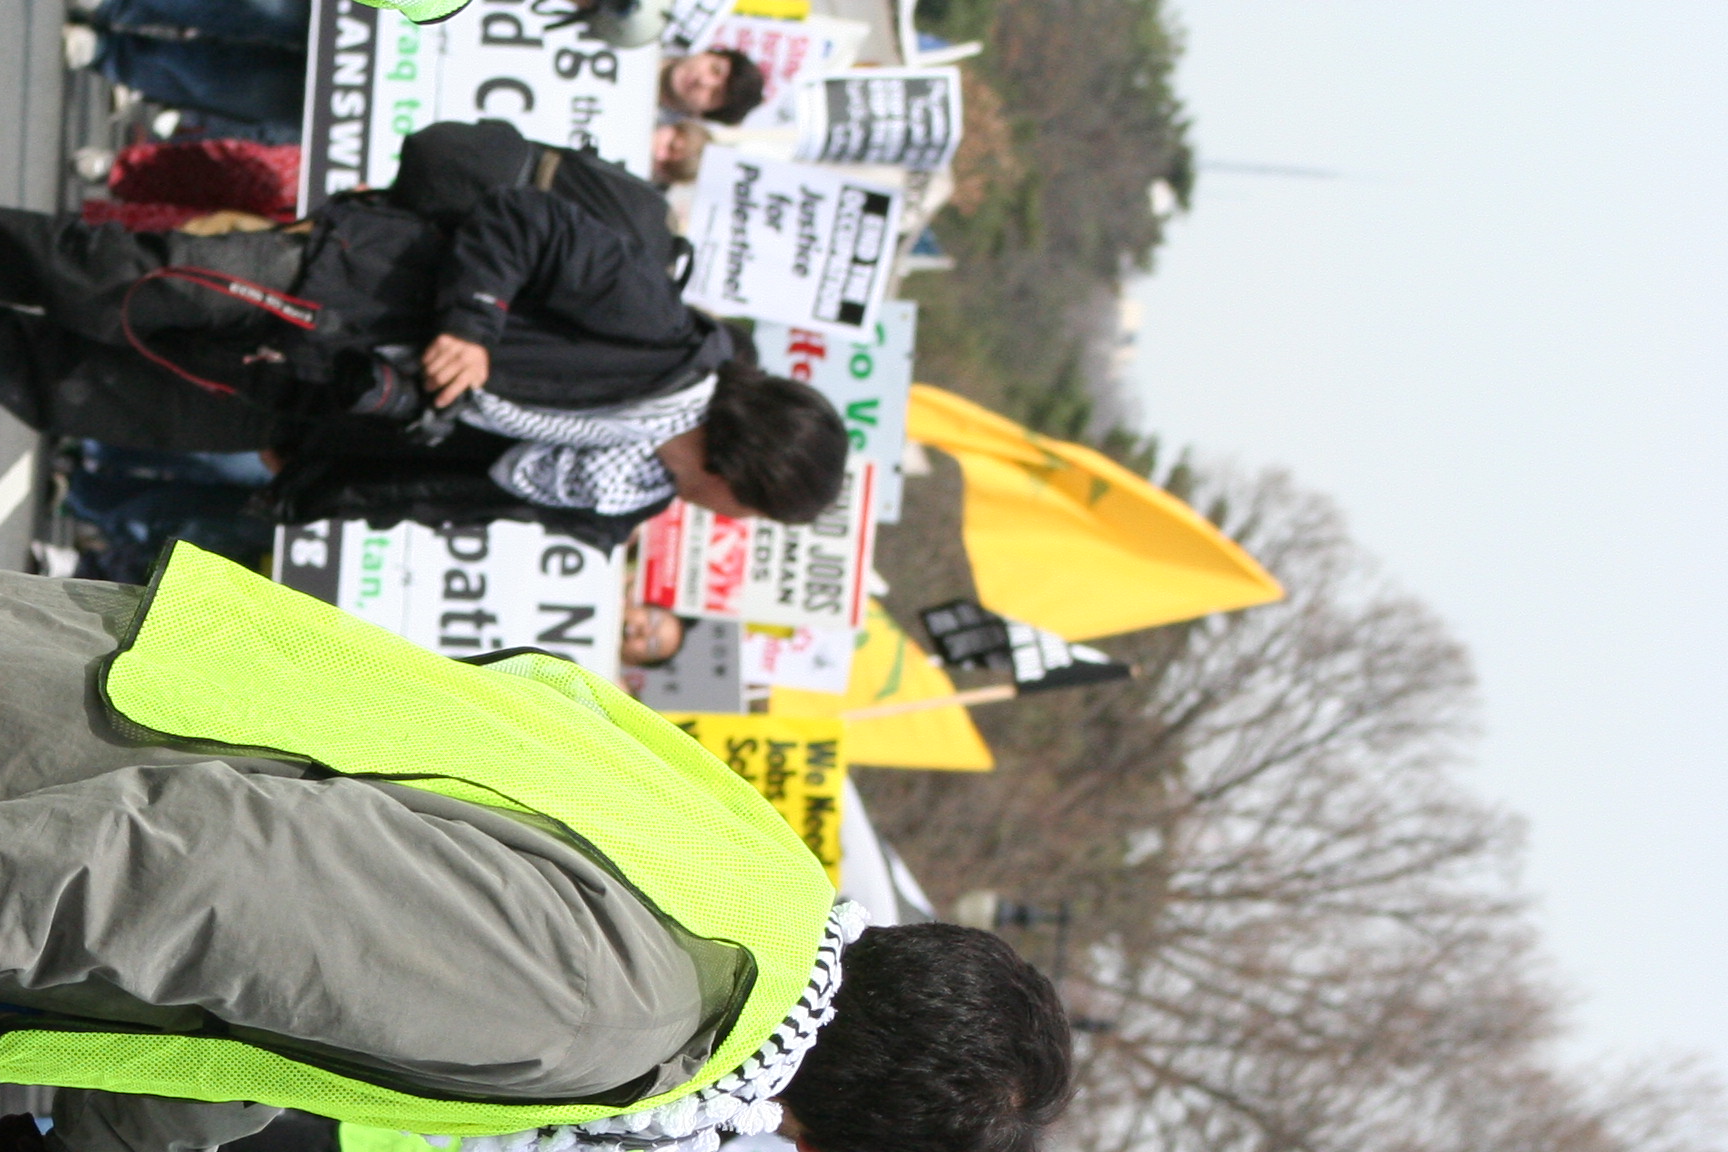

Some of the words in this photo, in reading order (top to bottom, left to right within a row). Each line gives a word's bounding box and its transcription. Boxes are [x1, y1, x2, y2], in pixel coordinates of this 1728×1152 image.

[385, 19, 421, 82] raq
[392, 99, 422, 135] to
[568, 96, 602, 150] the
[723, 163, 762, 303] Palestine!
[767, 194, 794, 234] for
[793, 186, 824, 278] Justice
[804, 545, 846, 614] JOBS
[766, 739, 798, 801] Jobs
[806, 740, 838, 786] We
